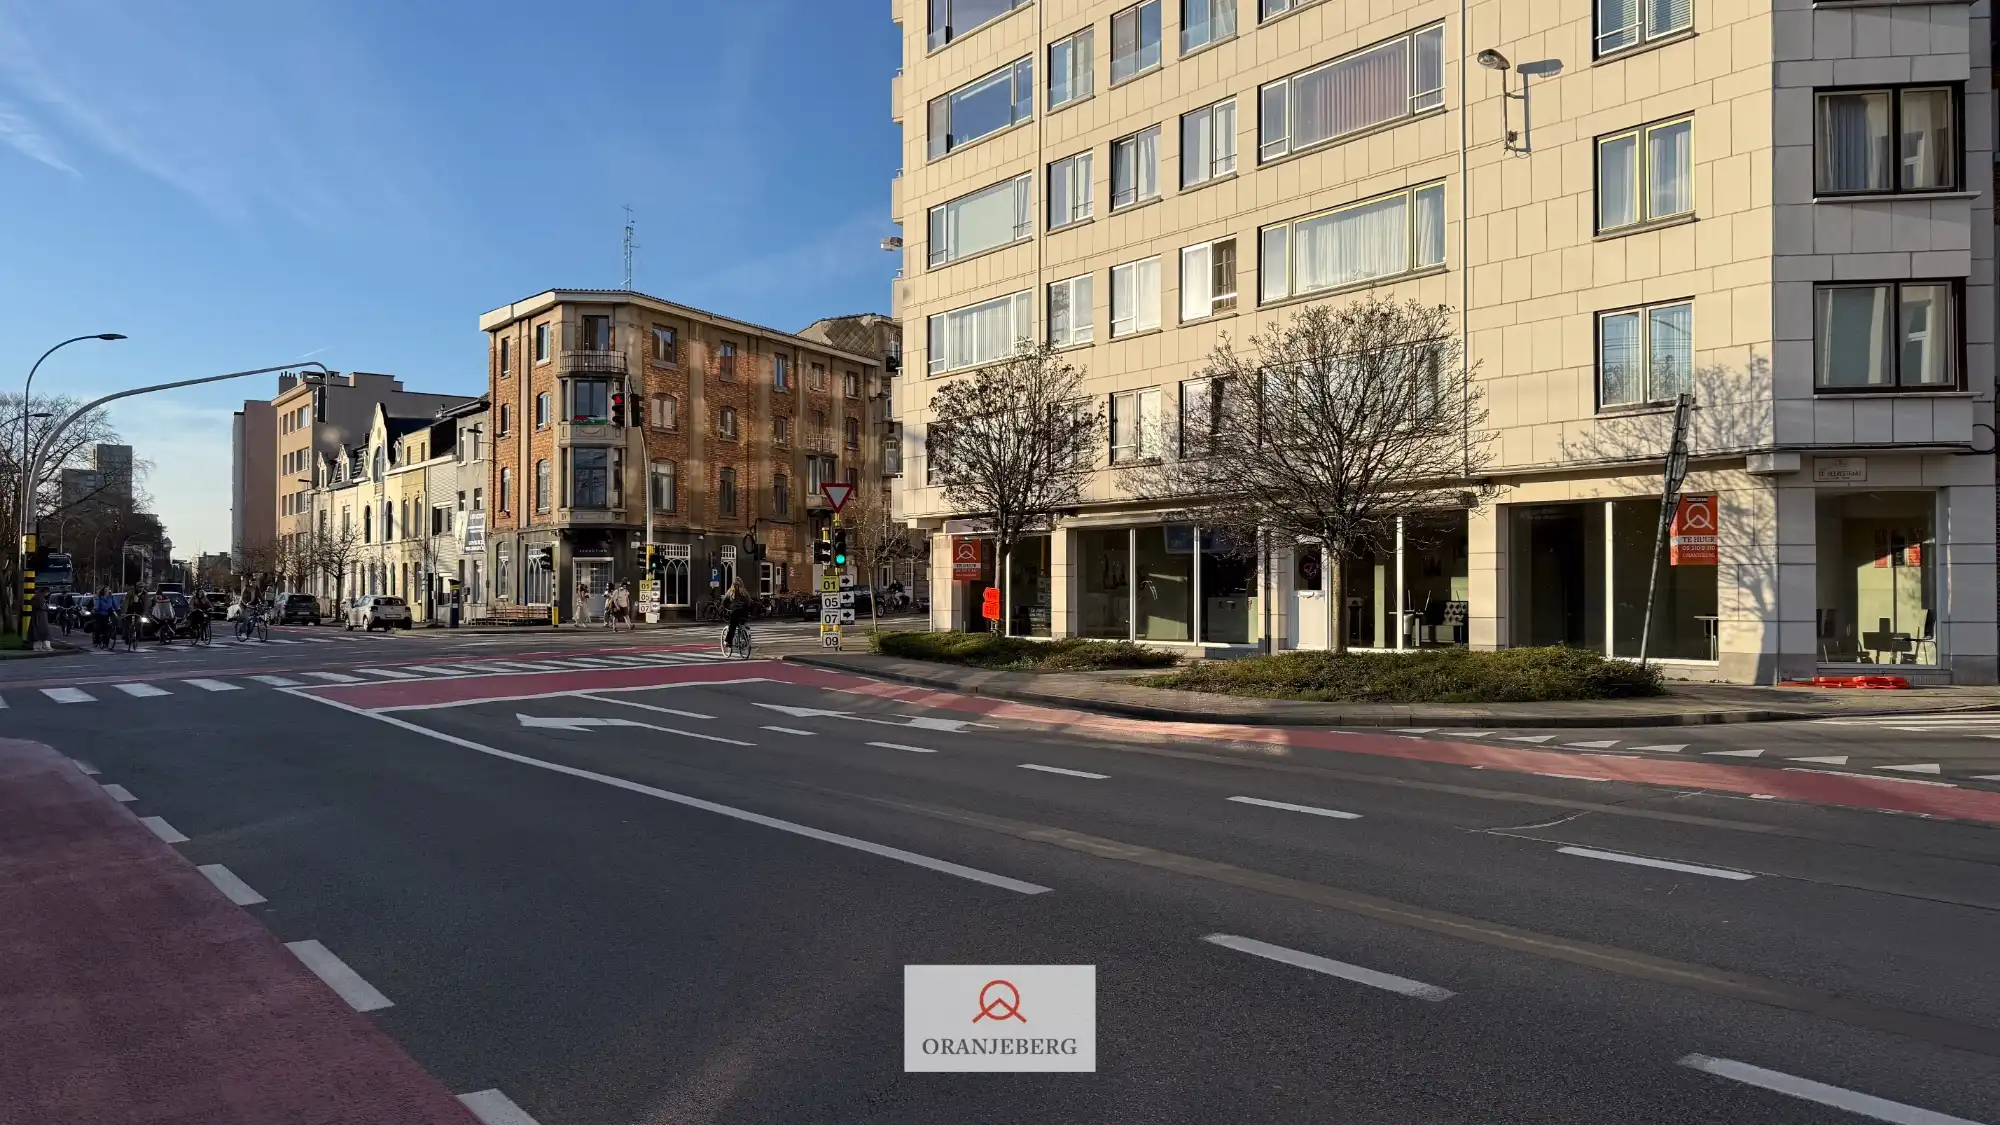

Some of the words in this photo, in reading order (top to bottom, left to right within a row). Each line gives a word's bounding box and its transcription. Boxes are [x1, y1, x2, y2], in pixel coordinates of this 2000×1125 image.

[712, 568, 718, 580] P
[823, 580, 836, 590] 01
[824, 597, 839, 608] 05
[824, 614, 838, 624] 07
[825, 636, 839, 646] 09
